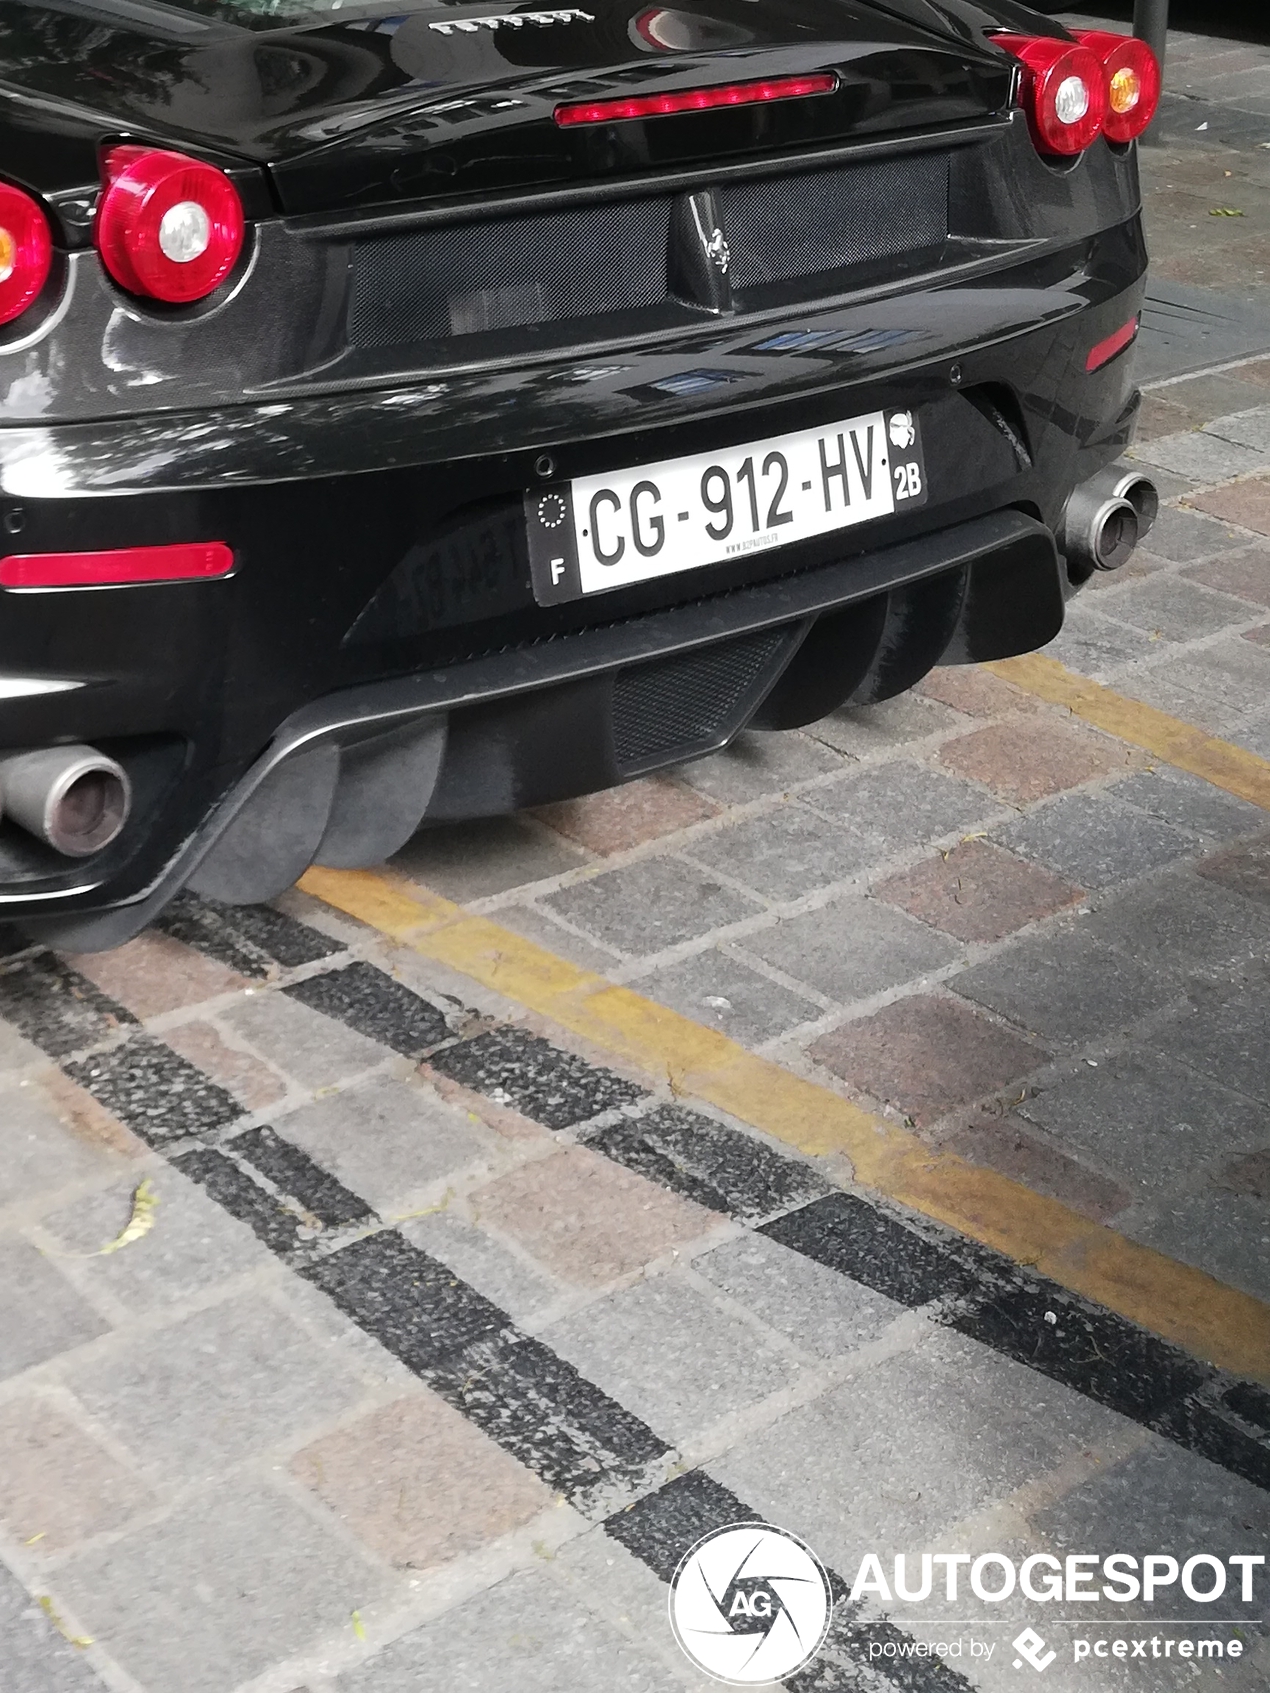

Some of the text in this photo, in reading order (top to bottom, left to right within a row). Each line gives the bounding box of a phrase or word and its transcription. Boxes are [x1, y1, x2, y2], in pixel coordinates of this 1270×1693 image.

[589, 425, 875, 567] CG-912-HV
[893, 461, 922, 501] 2B
[550, 558, 565, 585] F
